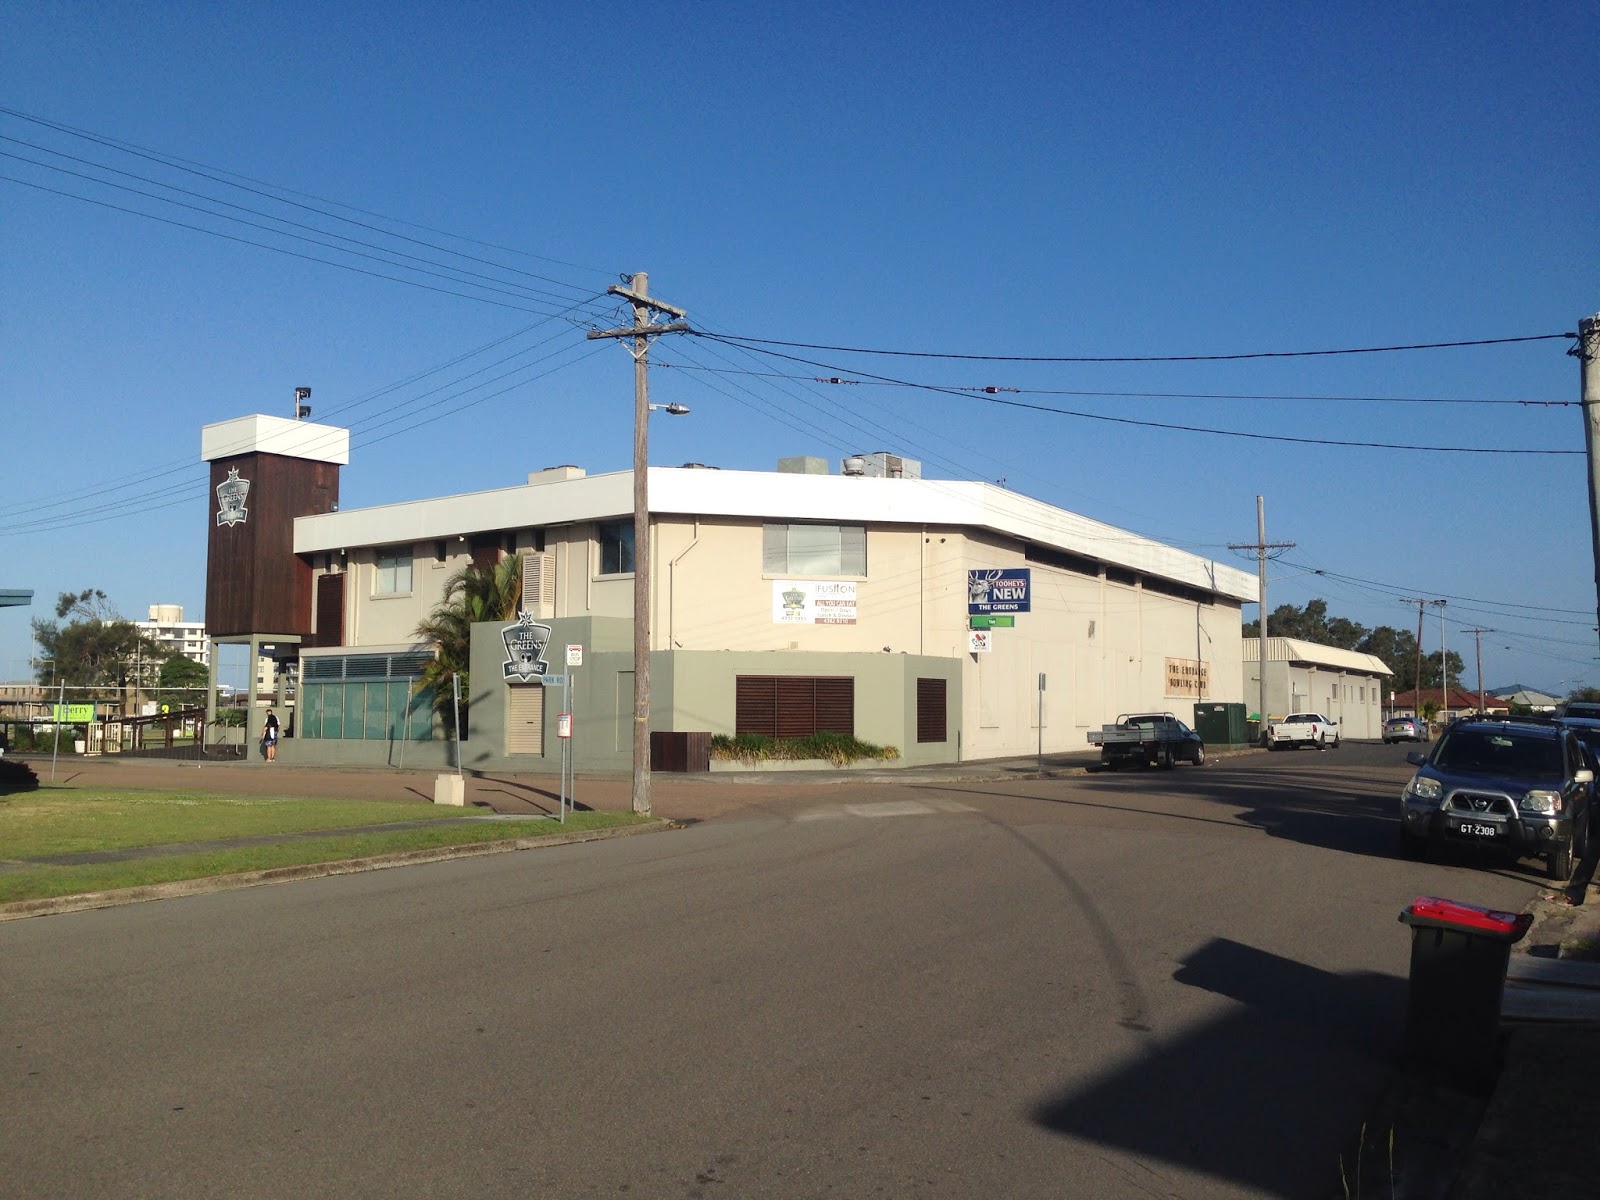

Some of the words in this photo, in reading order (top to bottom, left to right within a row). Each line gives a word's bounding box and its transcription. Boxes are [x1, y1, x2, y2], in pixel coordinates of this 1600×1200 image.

[993, 587, 1026, 600] NEW
[519, 631, 533, 640] THE
[510, 639, 543, 651] GREENS
[508, 664, 519, 673] THE
[518, 664, 543, 673] ENTRANCE
[1181, 666, 1207, 677] ENTRACE
